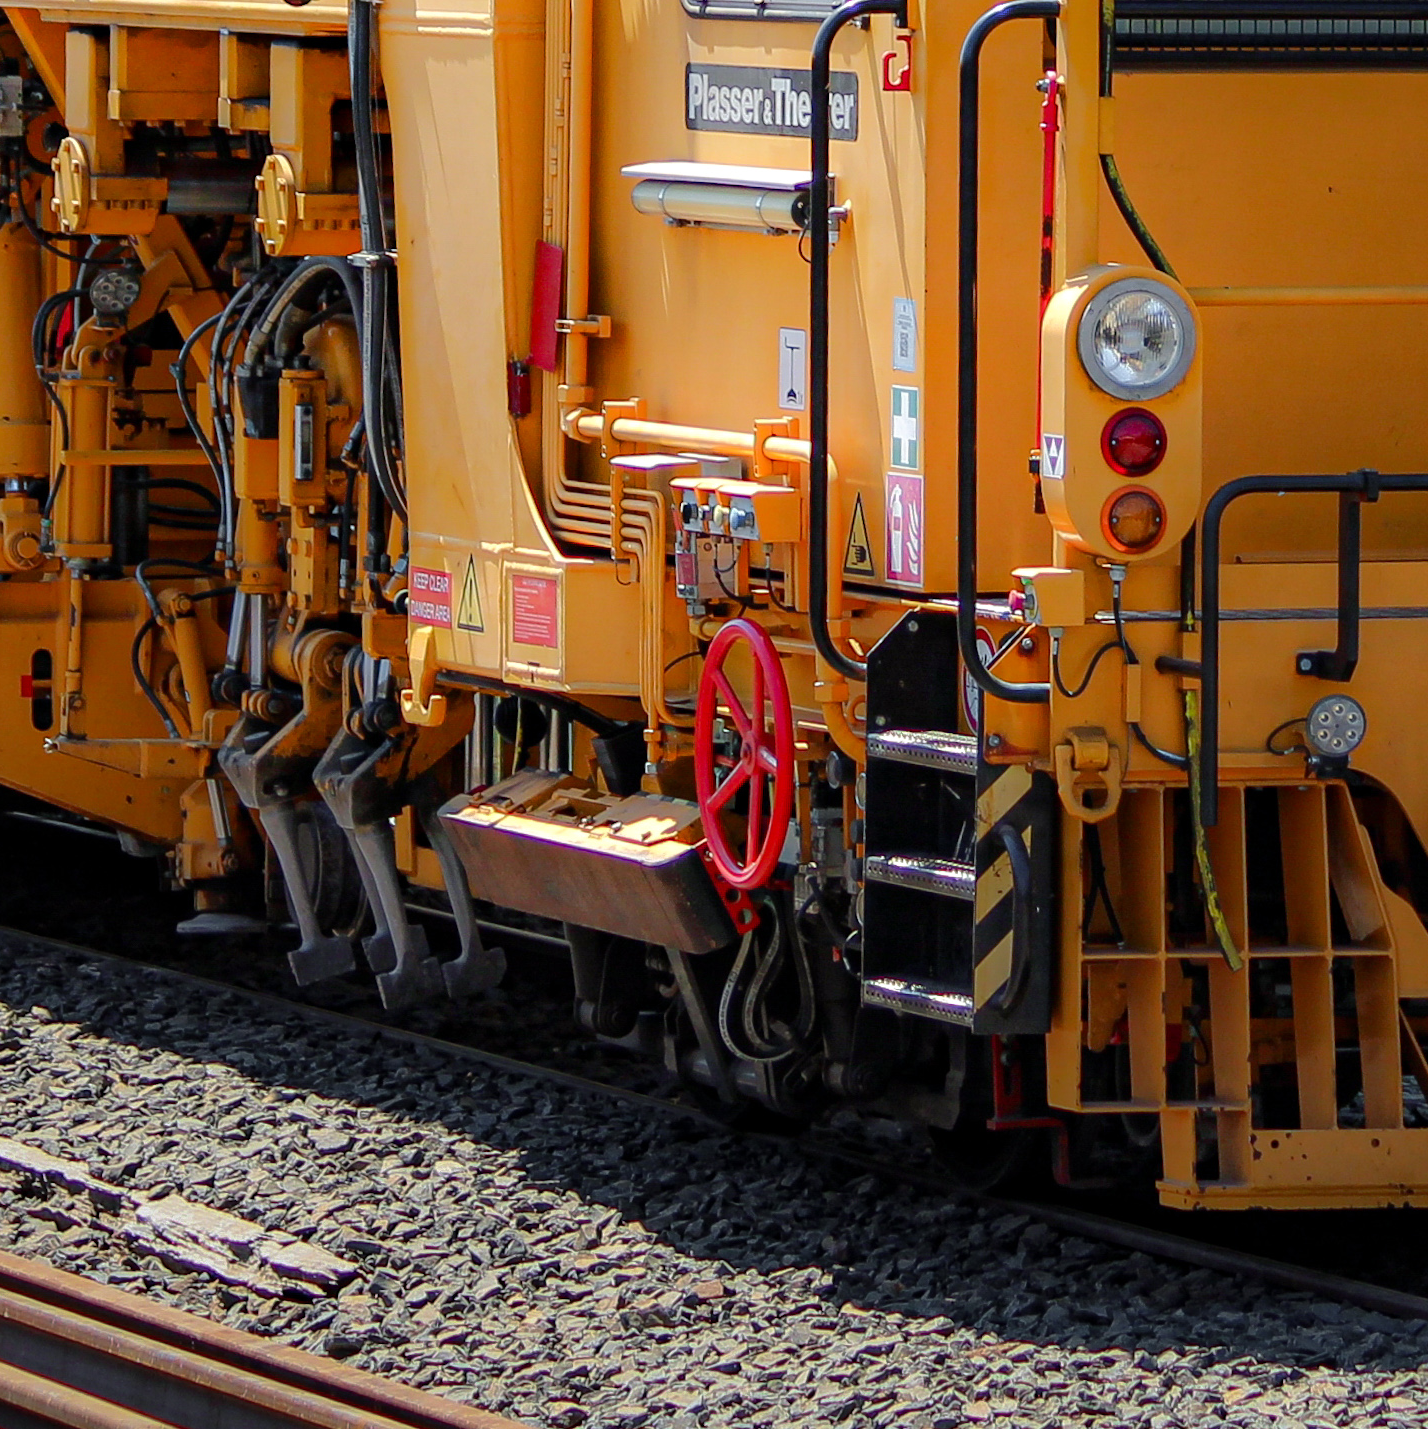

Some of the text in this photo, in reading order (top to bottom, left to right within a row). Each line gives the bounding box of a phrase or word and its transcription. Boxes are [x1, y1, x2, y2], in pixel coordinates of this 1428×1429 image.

[413, 572, 449, 593] KEEP CLEAR
[410, 600, 451, 623] DANGER AREA
